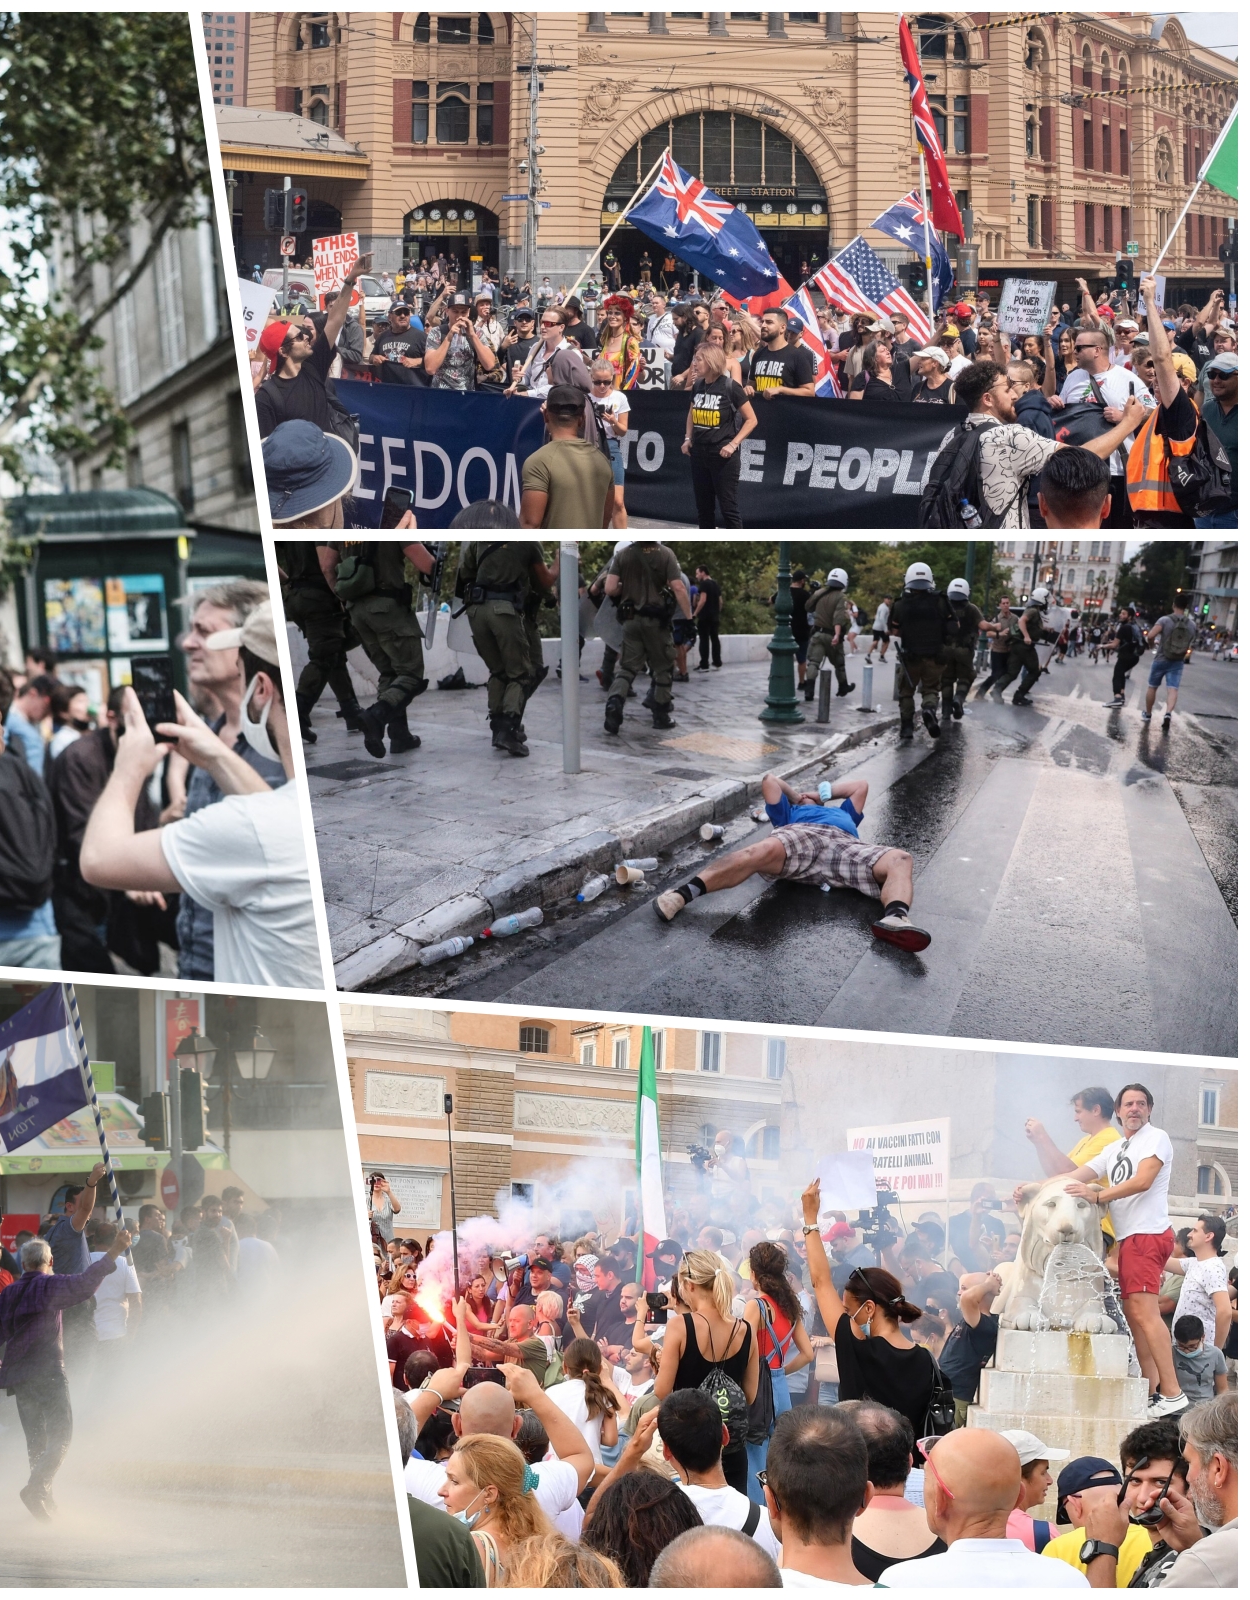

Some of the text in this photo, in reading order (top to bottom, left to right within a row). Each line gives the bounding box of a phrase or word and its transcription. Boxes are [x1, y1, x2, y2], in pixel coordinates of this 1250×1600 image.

[711, 187, 796, 197] REET STATION
[317, 233, 356, 252] THIS
[314, 248, 358, 268] ALL ENDS
[314, 265, 338, 282] WHEN
[1013, 295, 1040, 306] POWER
[1006, 305, 1047, 314] they wouldn't
[1005, 315, 1014, 323] try
[755, 361, 784, 376] WE ARE
[703, 394, 722, 409] ARE
[692, 410, 721, 427] OMING
[620, 429, 665, 472] TO
[852, 1130, 941, 1150] NO AI VACCINI FATTI CON
[872, 1152, 934, 1169] RATELLI ANIMALI.
[901, 1175, 916, 1190] POI
[917, 1173, 933, 1189] MAI
